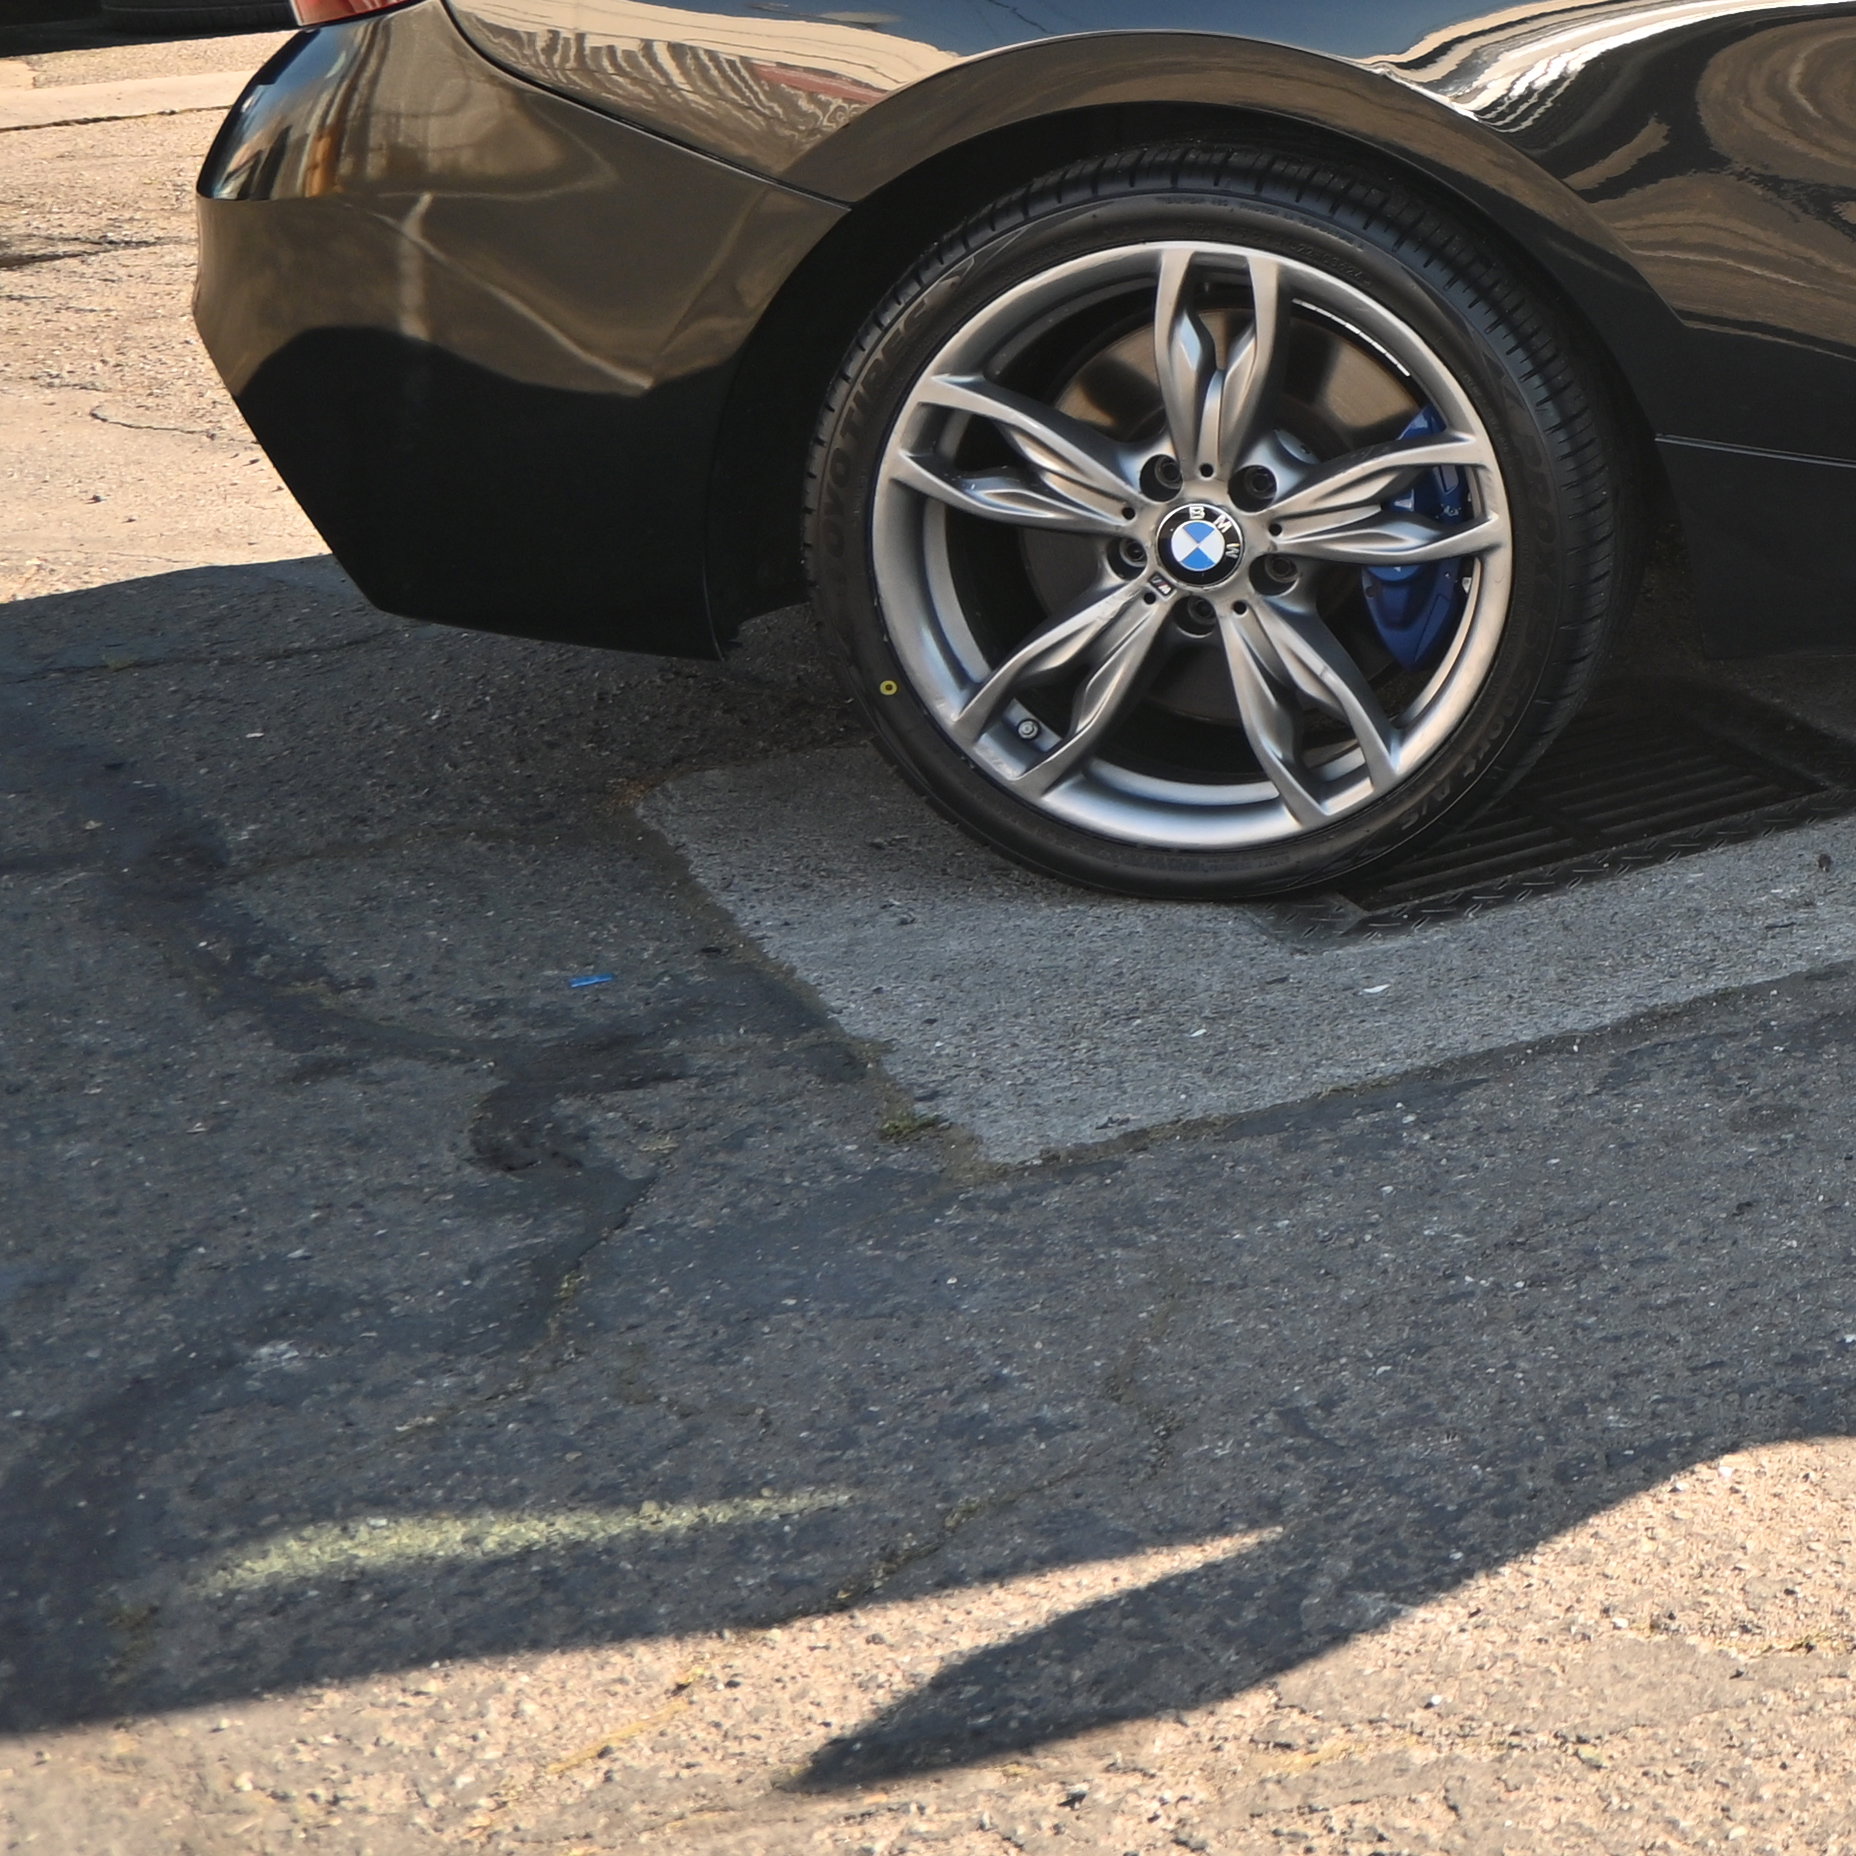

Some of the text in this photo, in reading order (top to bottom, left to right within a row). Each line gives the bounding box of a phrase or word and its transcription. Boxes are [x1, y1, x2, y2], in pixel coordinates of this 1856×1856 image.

[836, 299, 938, 442] TIRES
[1189, 506, 1240, 558] BMW
[1451, 667, 1536, 780] Sport
[1393, 775, 1458, 832] A/S
